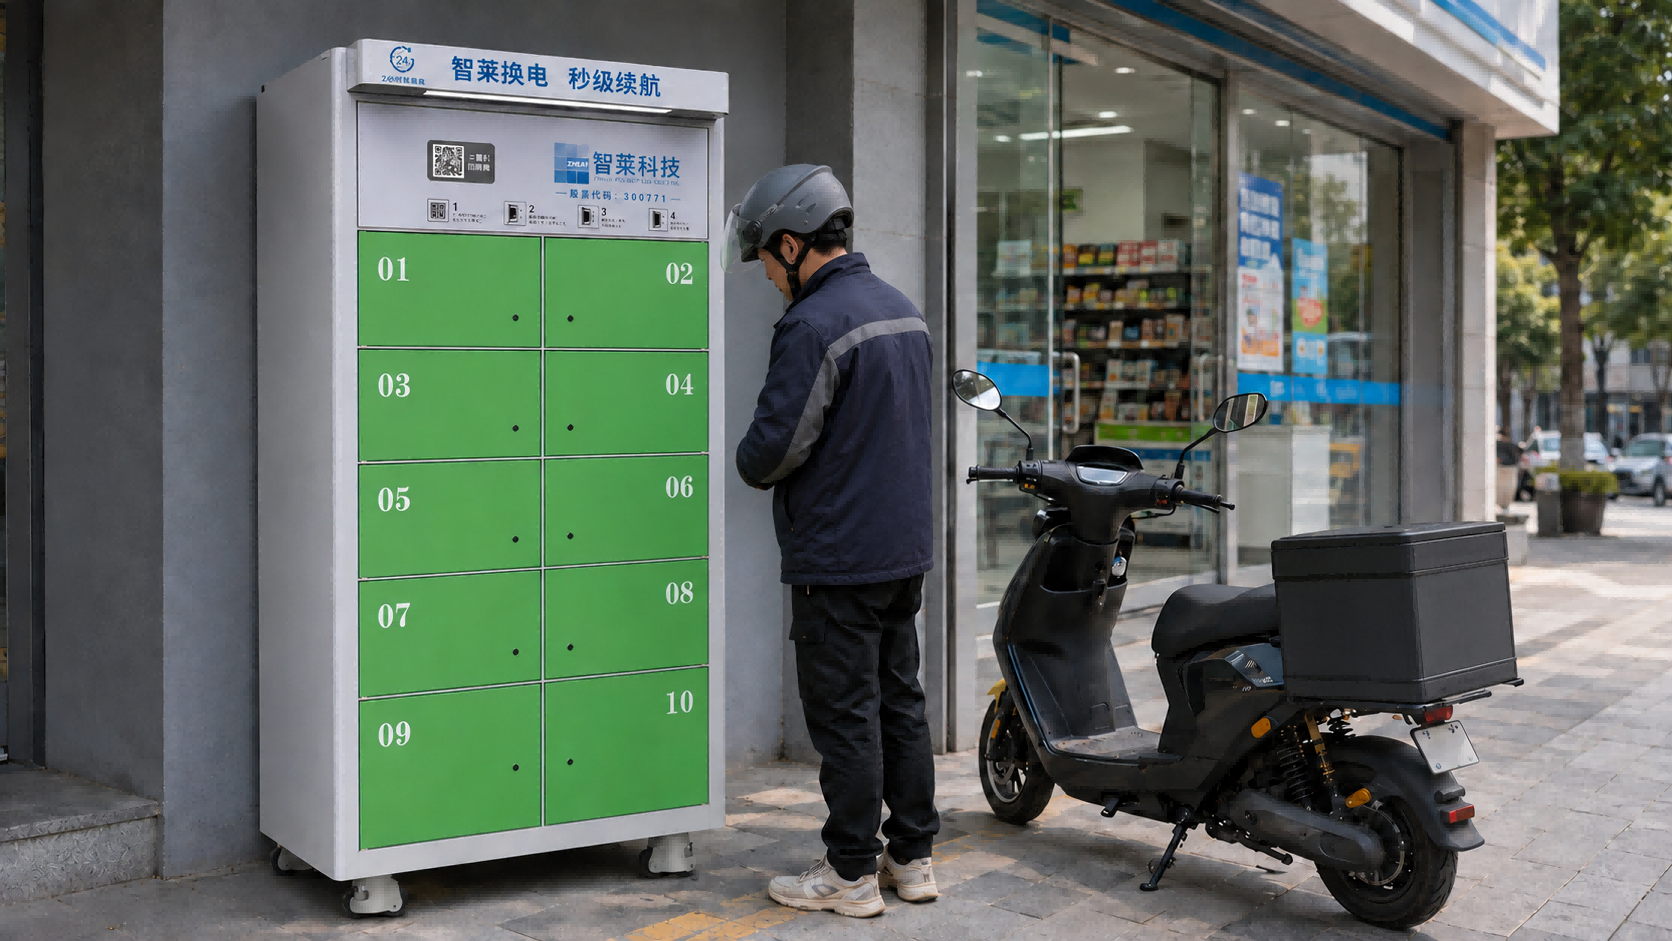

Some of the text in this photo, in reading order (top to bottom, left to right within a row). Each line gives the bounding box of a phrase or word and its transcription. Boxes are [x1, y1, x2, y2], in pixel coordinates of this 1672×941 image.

[452, 55, 662, 98] 智莱换电 秒级续航
[593, 151, 681, 179] 智莱科技
[453, 202, 458, 211] 1
[529, 204, 535, 213] 2
[601, 207, 607, 217] 3
[670, 211, 676, 220] 4
[378, 256, 410, 282] 01
[665, 262, 693, 285] 02
[377, 372, 411, 398] 03
[665, 373, 694, 396] 04
[377, 486, 411, 513] 05
[665, 475, 694, 499] 06
[665, 580, 694, 605] 08
[377, 602, 411, 629] 07
[666, 690, 694, 715] 10
[378, 720, 411, 748] 09
